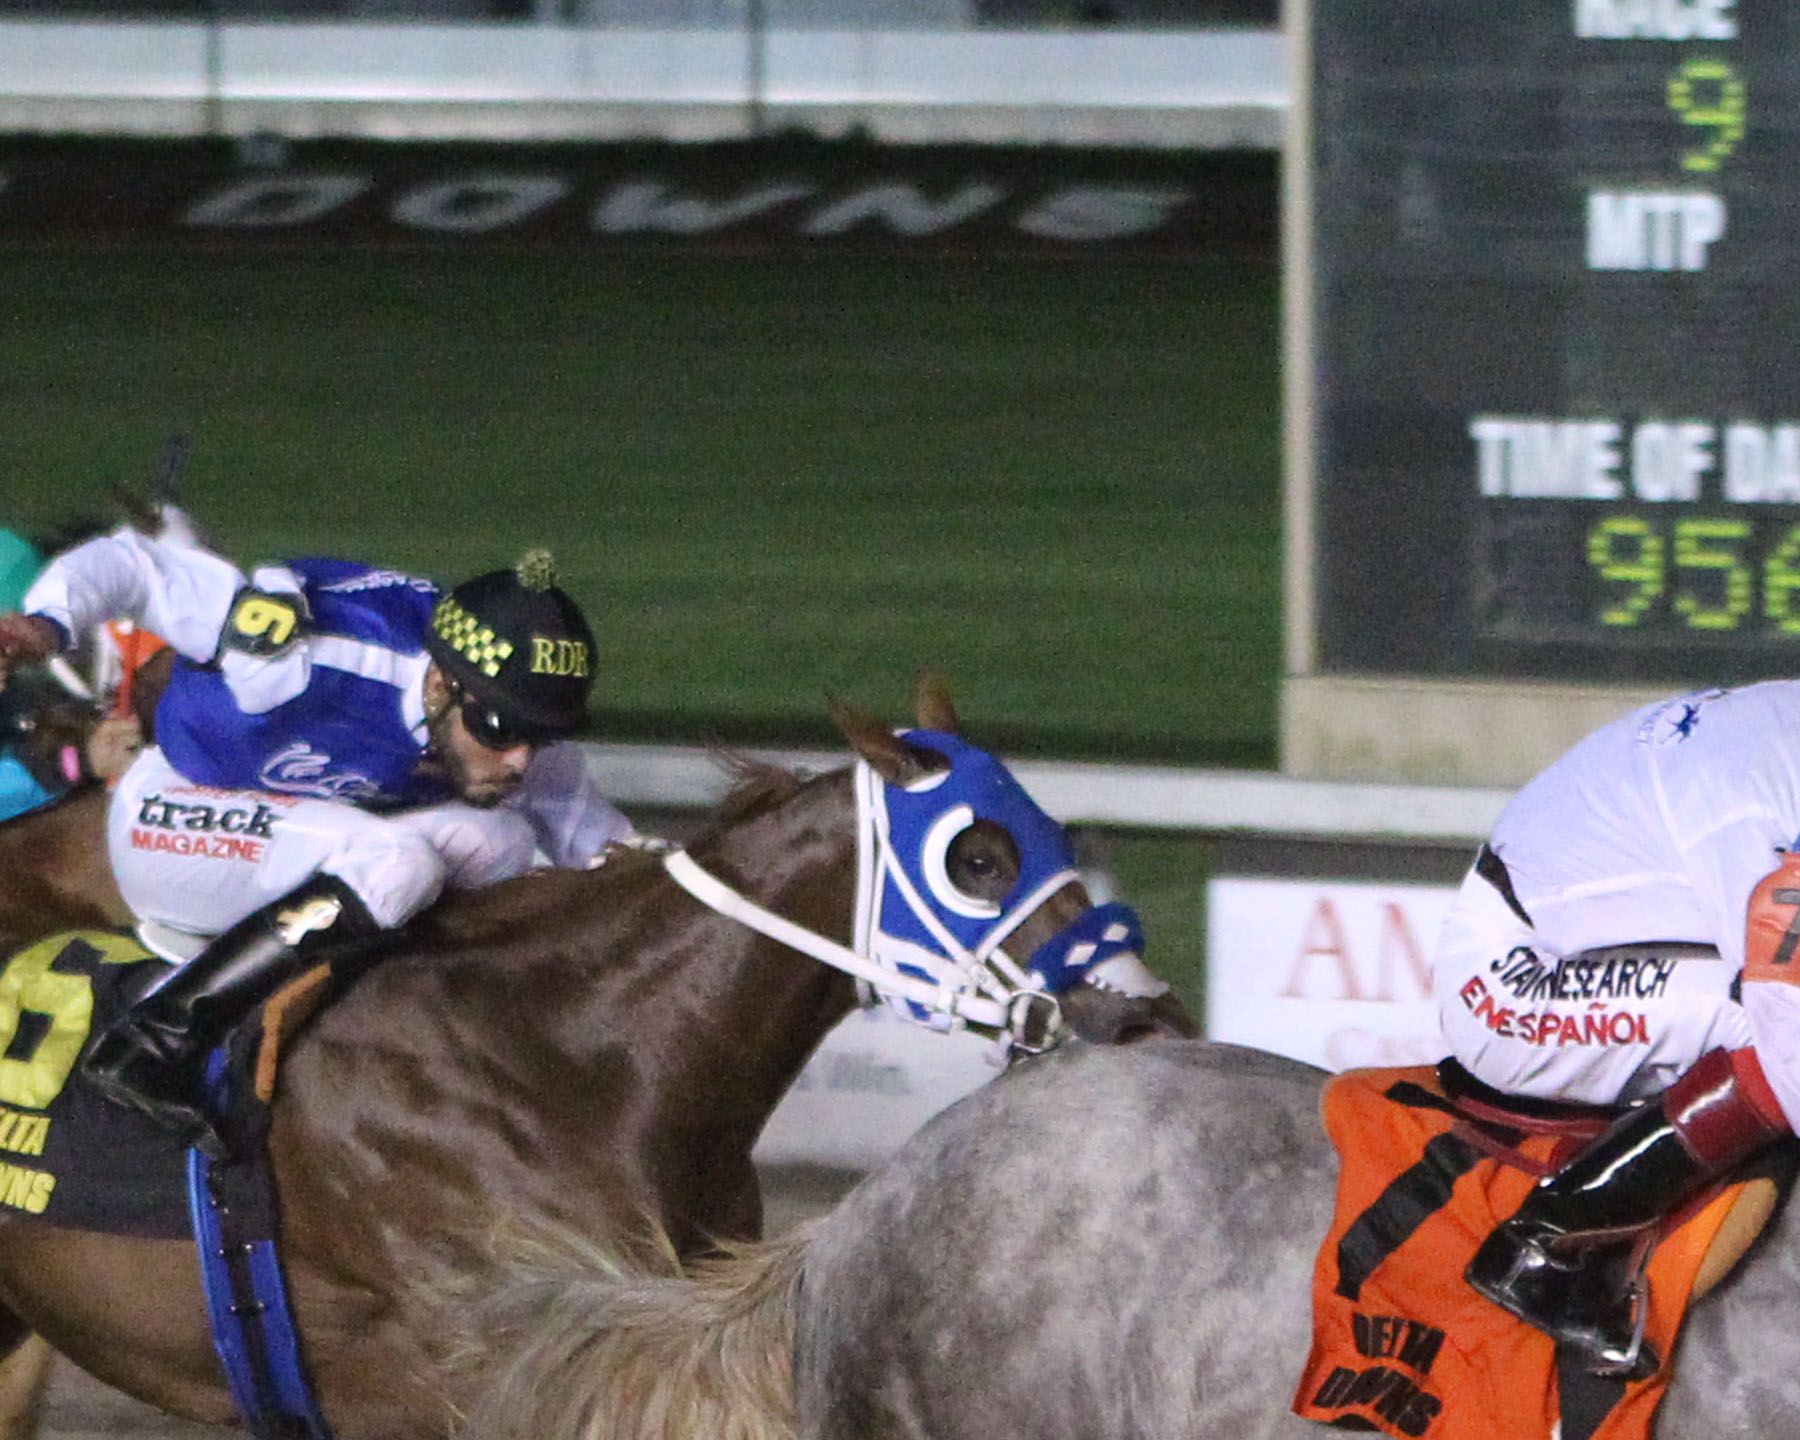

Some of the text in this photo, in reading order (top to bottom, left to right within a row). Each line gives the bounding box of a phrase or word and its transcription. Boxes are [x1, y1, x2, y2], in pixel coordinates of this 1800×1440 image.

[1667, 58, 1746, 171] 9
[1587, 190, 1727, 271] MTP
[1470, 417, 1623, 499] TIME
[1631, 419, 1715, 501] OF
[131, 828, 264, 863] MAGAZINE
[138, 793, 283, 840] track
